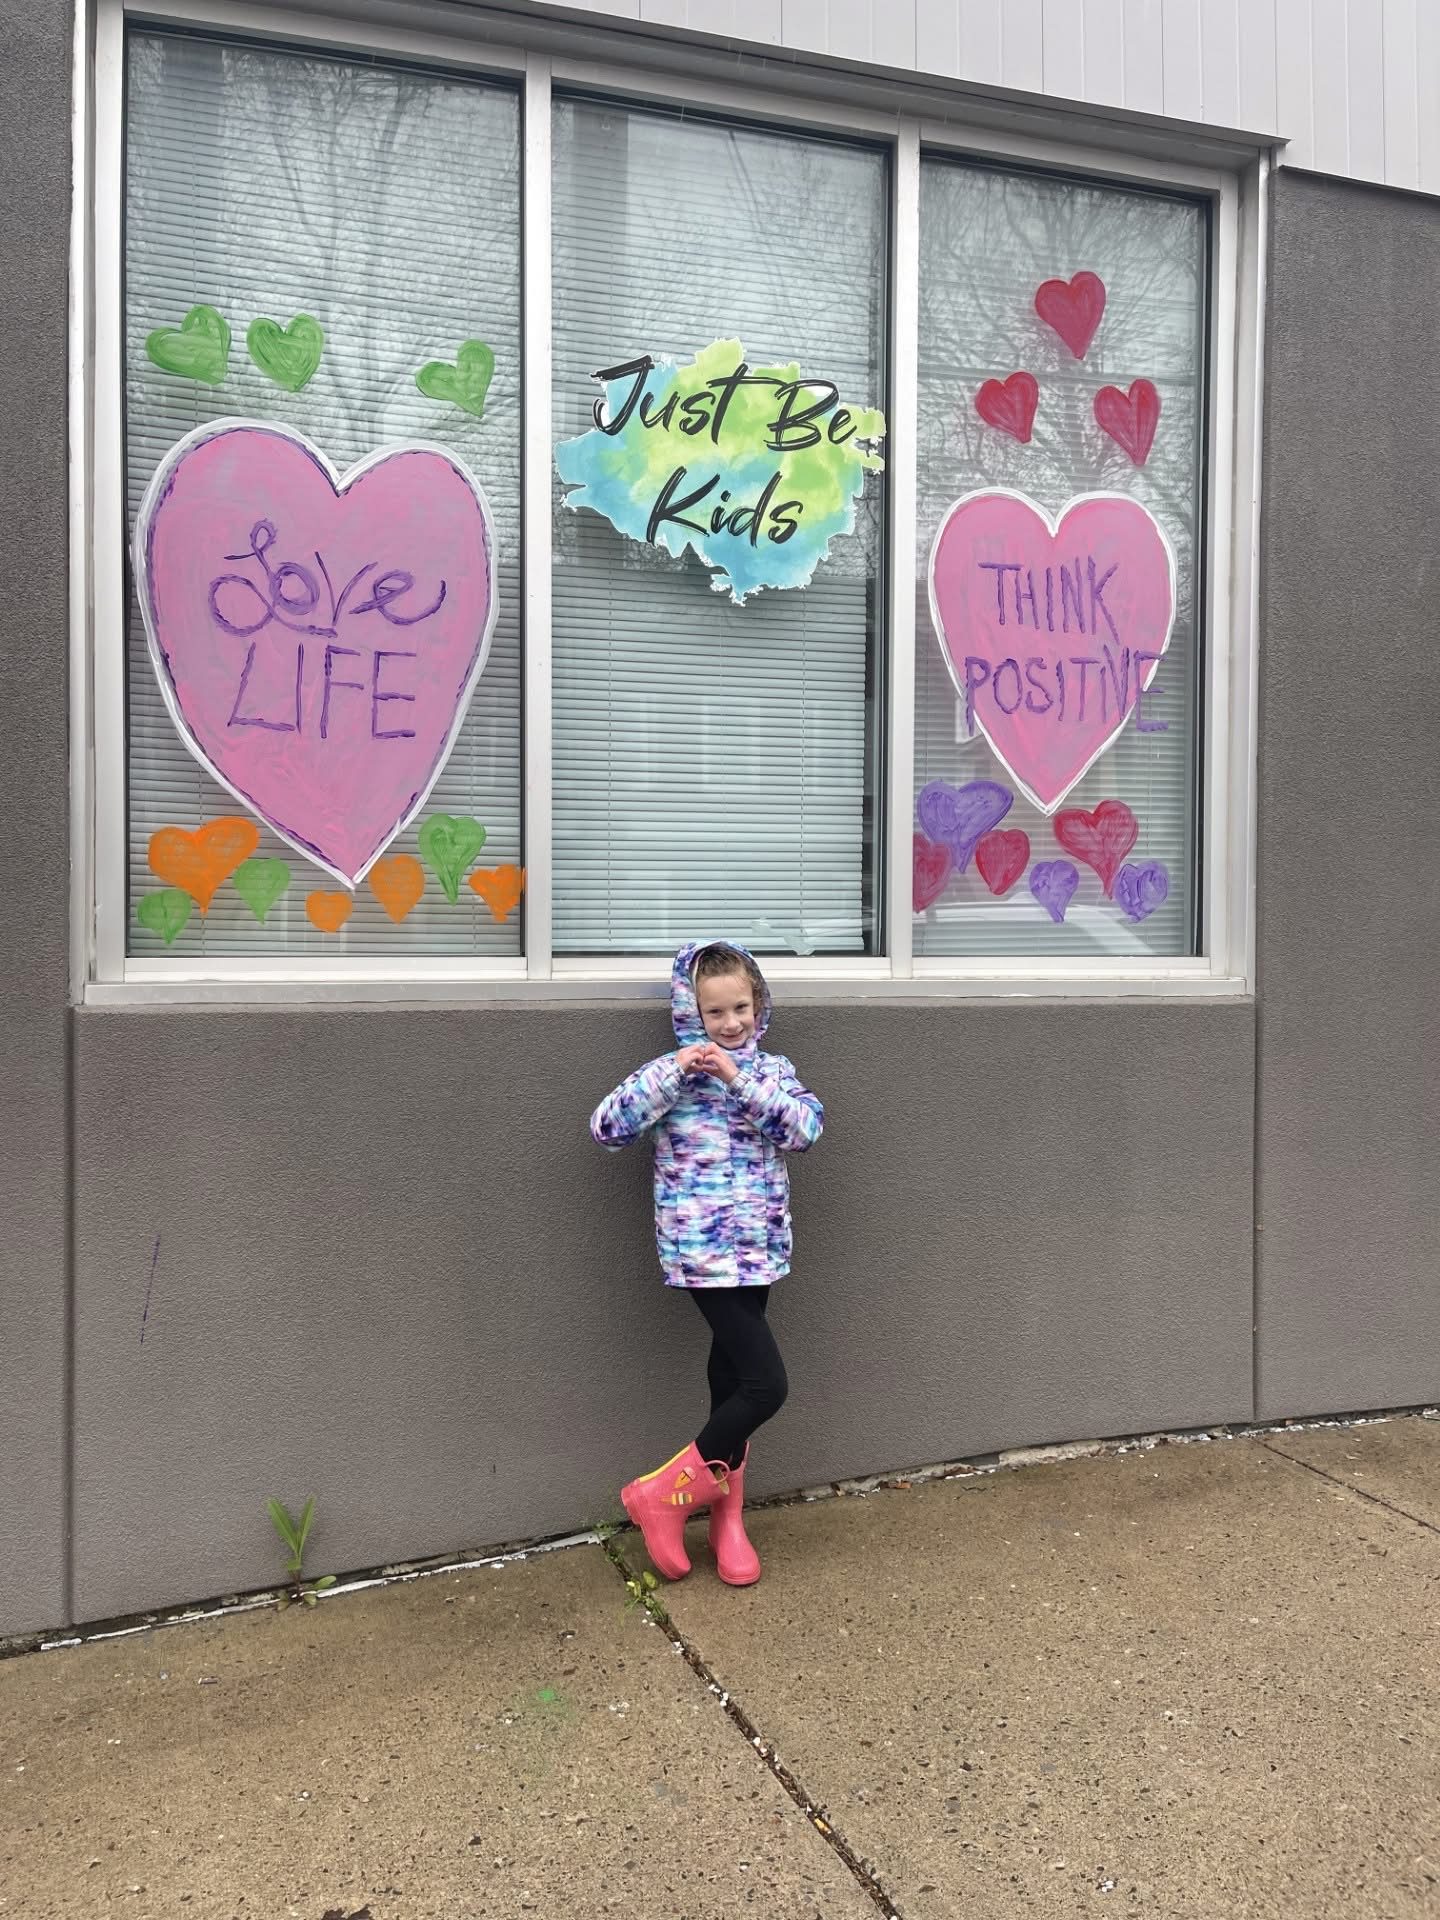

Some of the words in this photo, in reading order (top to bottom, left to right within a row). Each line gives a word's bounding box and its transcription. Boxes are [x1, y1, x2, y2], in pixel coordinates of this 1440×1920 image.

[590, 353, 784, 446] Just
[763, 377, 858, 452] Be
[645, 465, 804, 549] Kids
[977, 554, 1121, 646] THINK
[226, 641, 417, 739] LIFE
